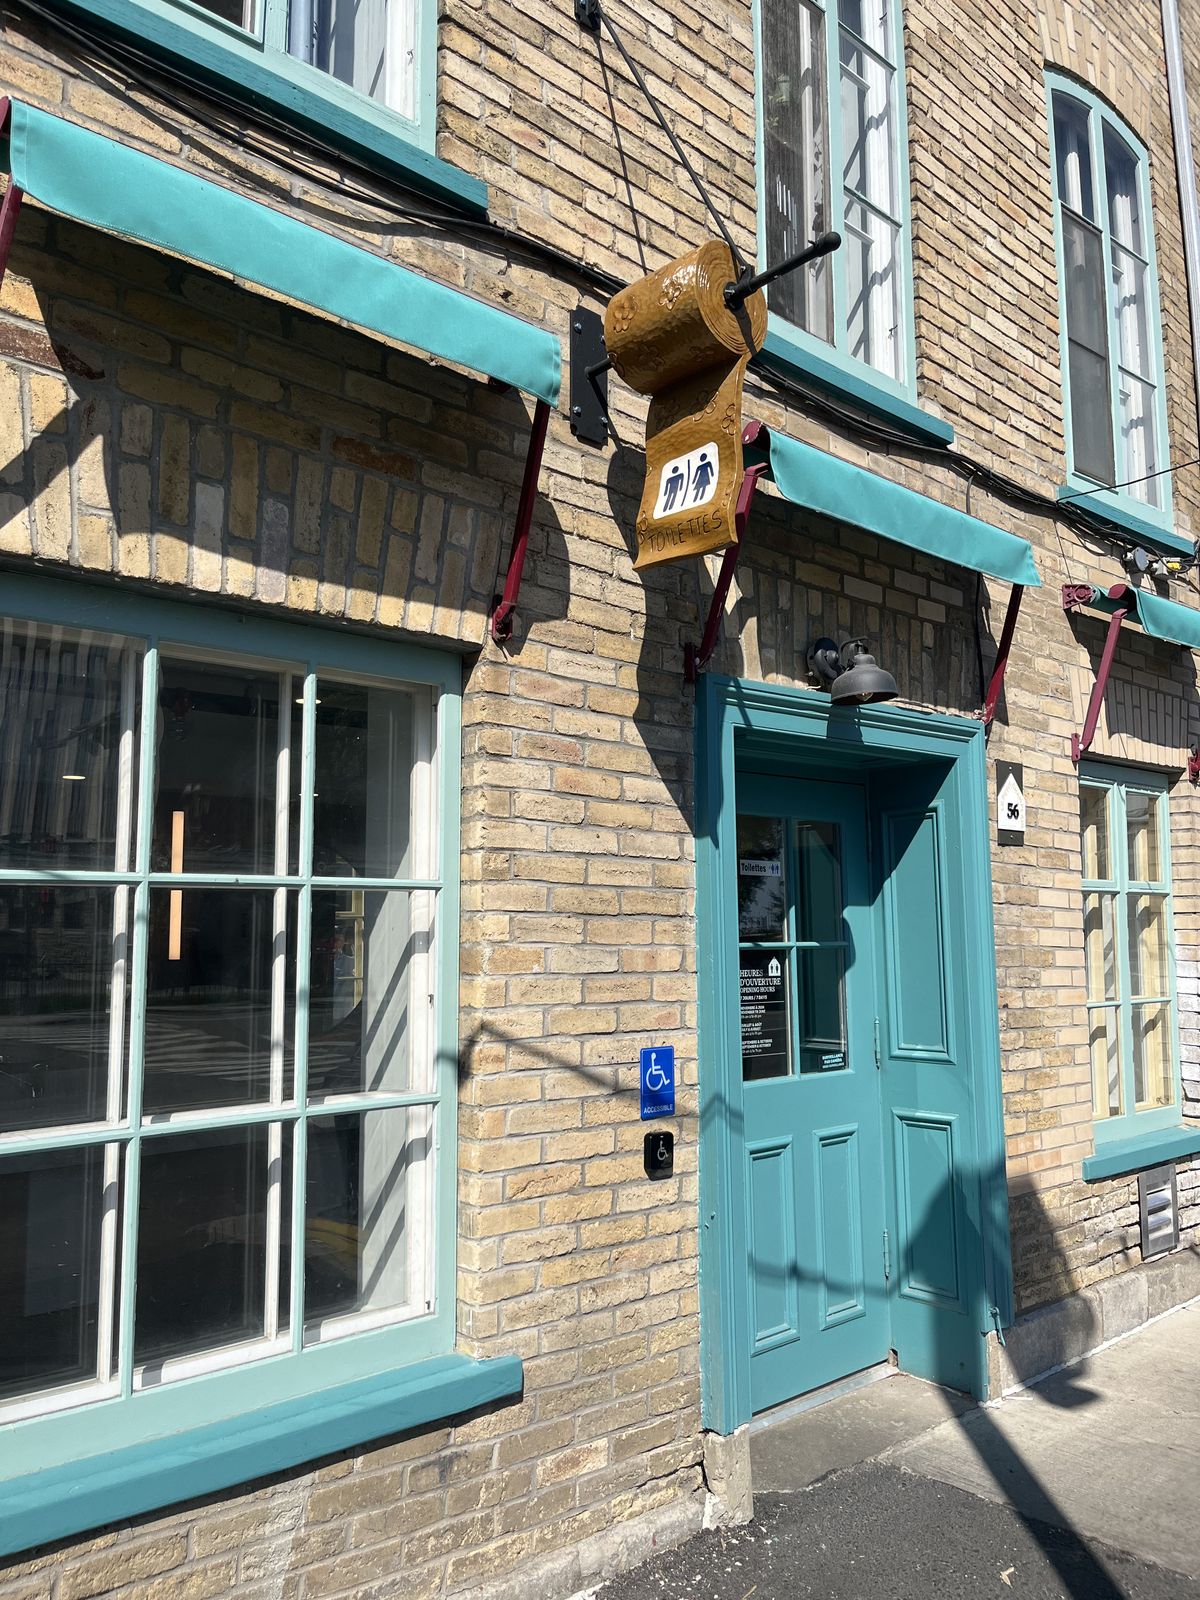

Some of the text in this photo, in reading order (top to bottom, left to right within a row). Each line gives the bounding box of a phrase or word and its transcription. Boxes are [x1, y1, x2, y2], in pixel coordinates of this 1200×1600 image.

[647, 508, 722, 552] TOILETTES
[1007, 803, 1019, 820] 56
[741, 863, 767, 873] Toilettes
[740, 969, 763, 977] HEURES
[740, 978, 781, 986] D'OUVERTURE
[643, 1104, 673, 1114] ACCESSIBLE
